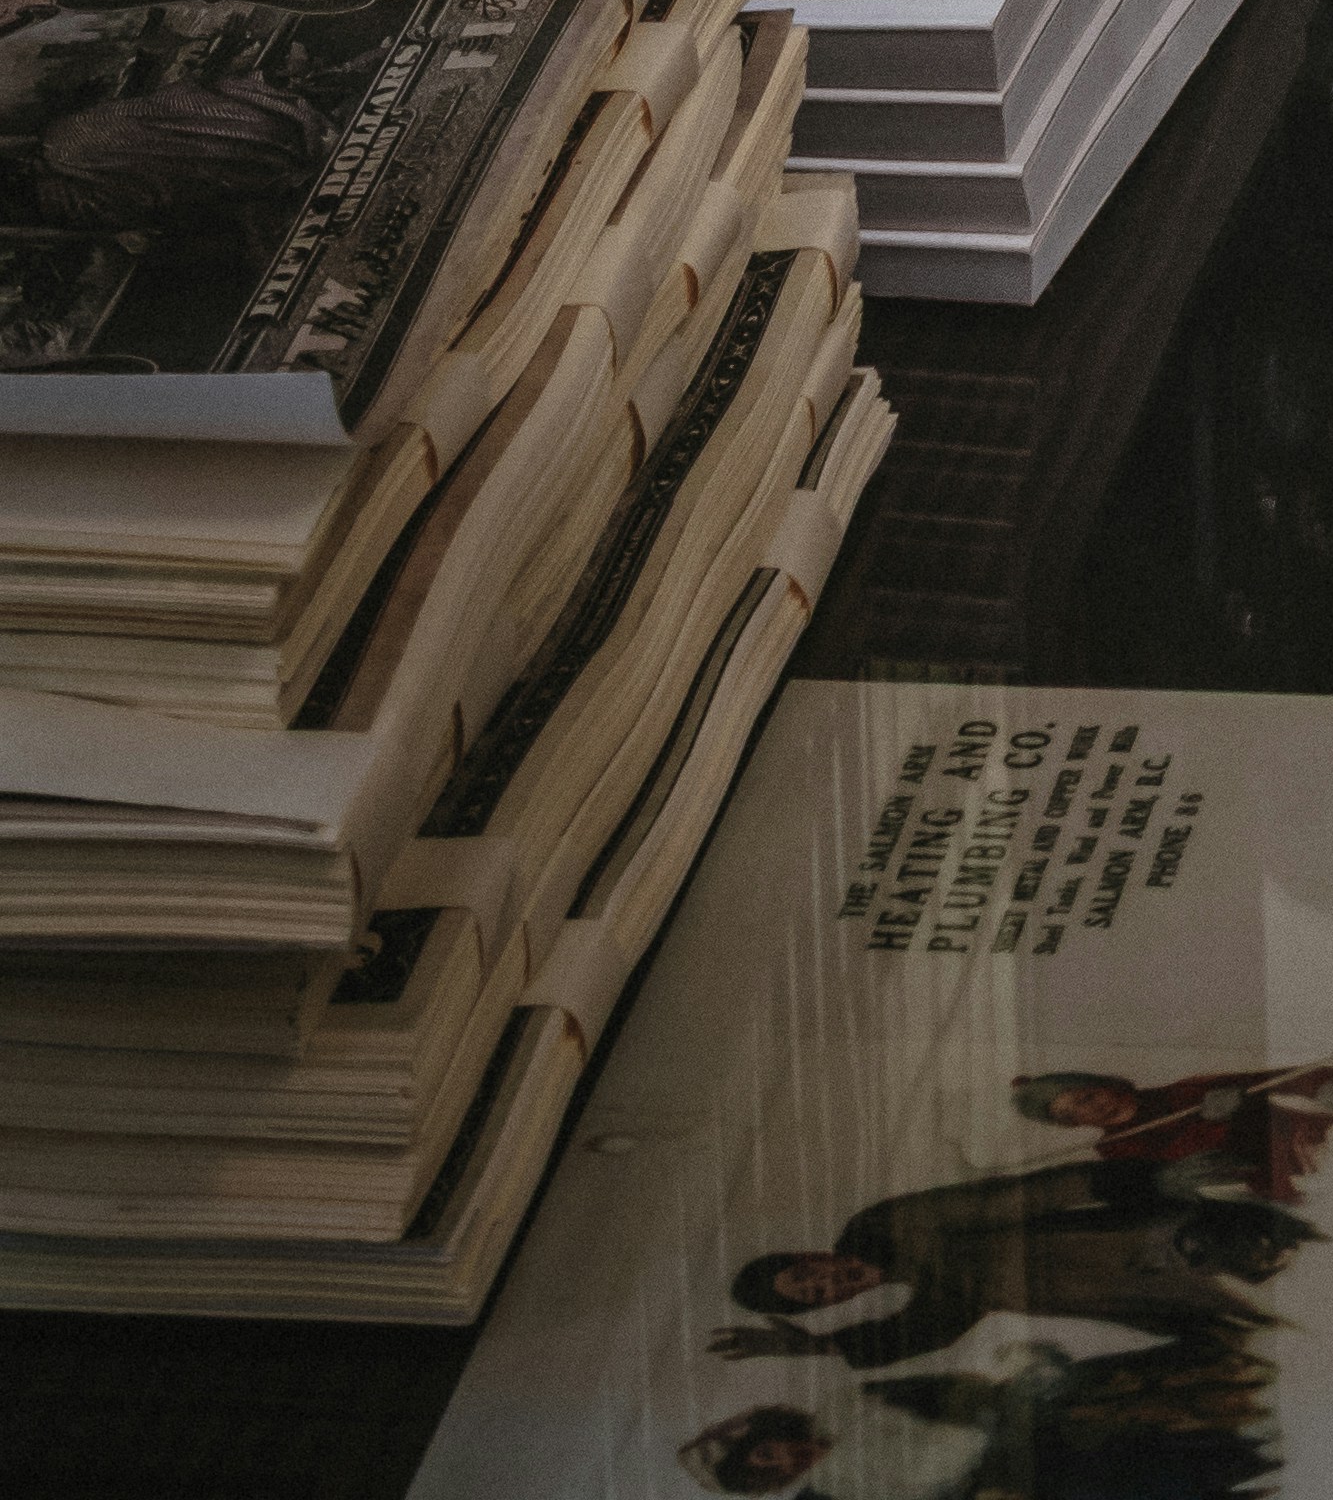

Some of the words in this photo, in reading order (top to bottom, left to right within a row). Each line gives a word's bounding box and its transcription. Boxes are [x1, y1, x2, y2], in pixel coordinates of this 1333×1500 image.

[316, 42, 422, 201] DOLLARS
[836, 882, 876, 920] THE
[858, 795, 913, 873] SALMON
[898, 745, 936, 784] ARM
[866, 809, 964, 951] HEATING
[942, 721, 997, 781] AND
[926, 788, 1030, 953] PLUMBING
[1004, 722, 1055, 770] CO.
[1085, 850, 1135, 929] SALMON
[1145, 826, 1191, 889] PHONE
